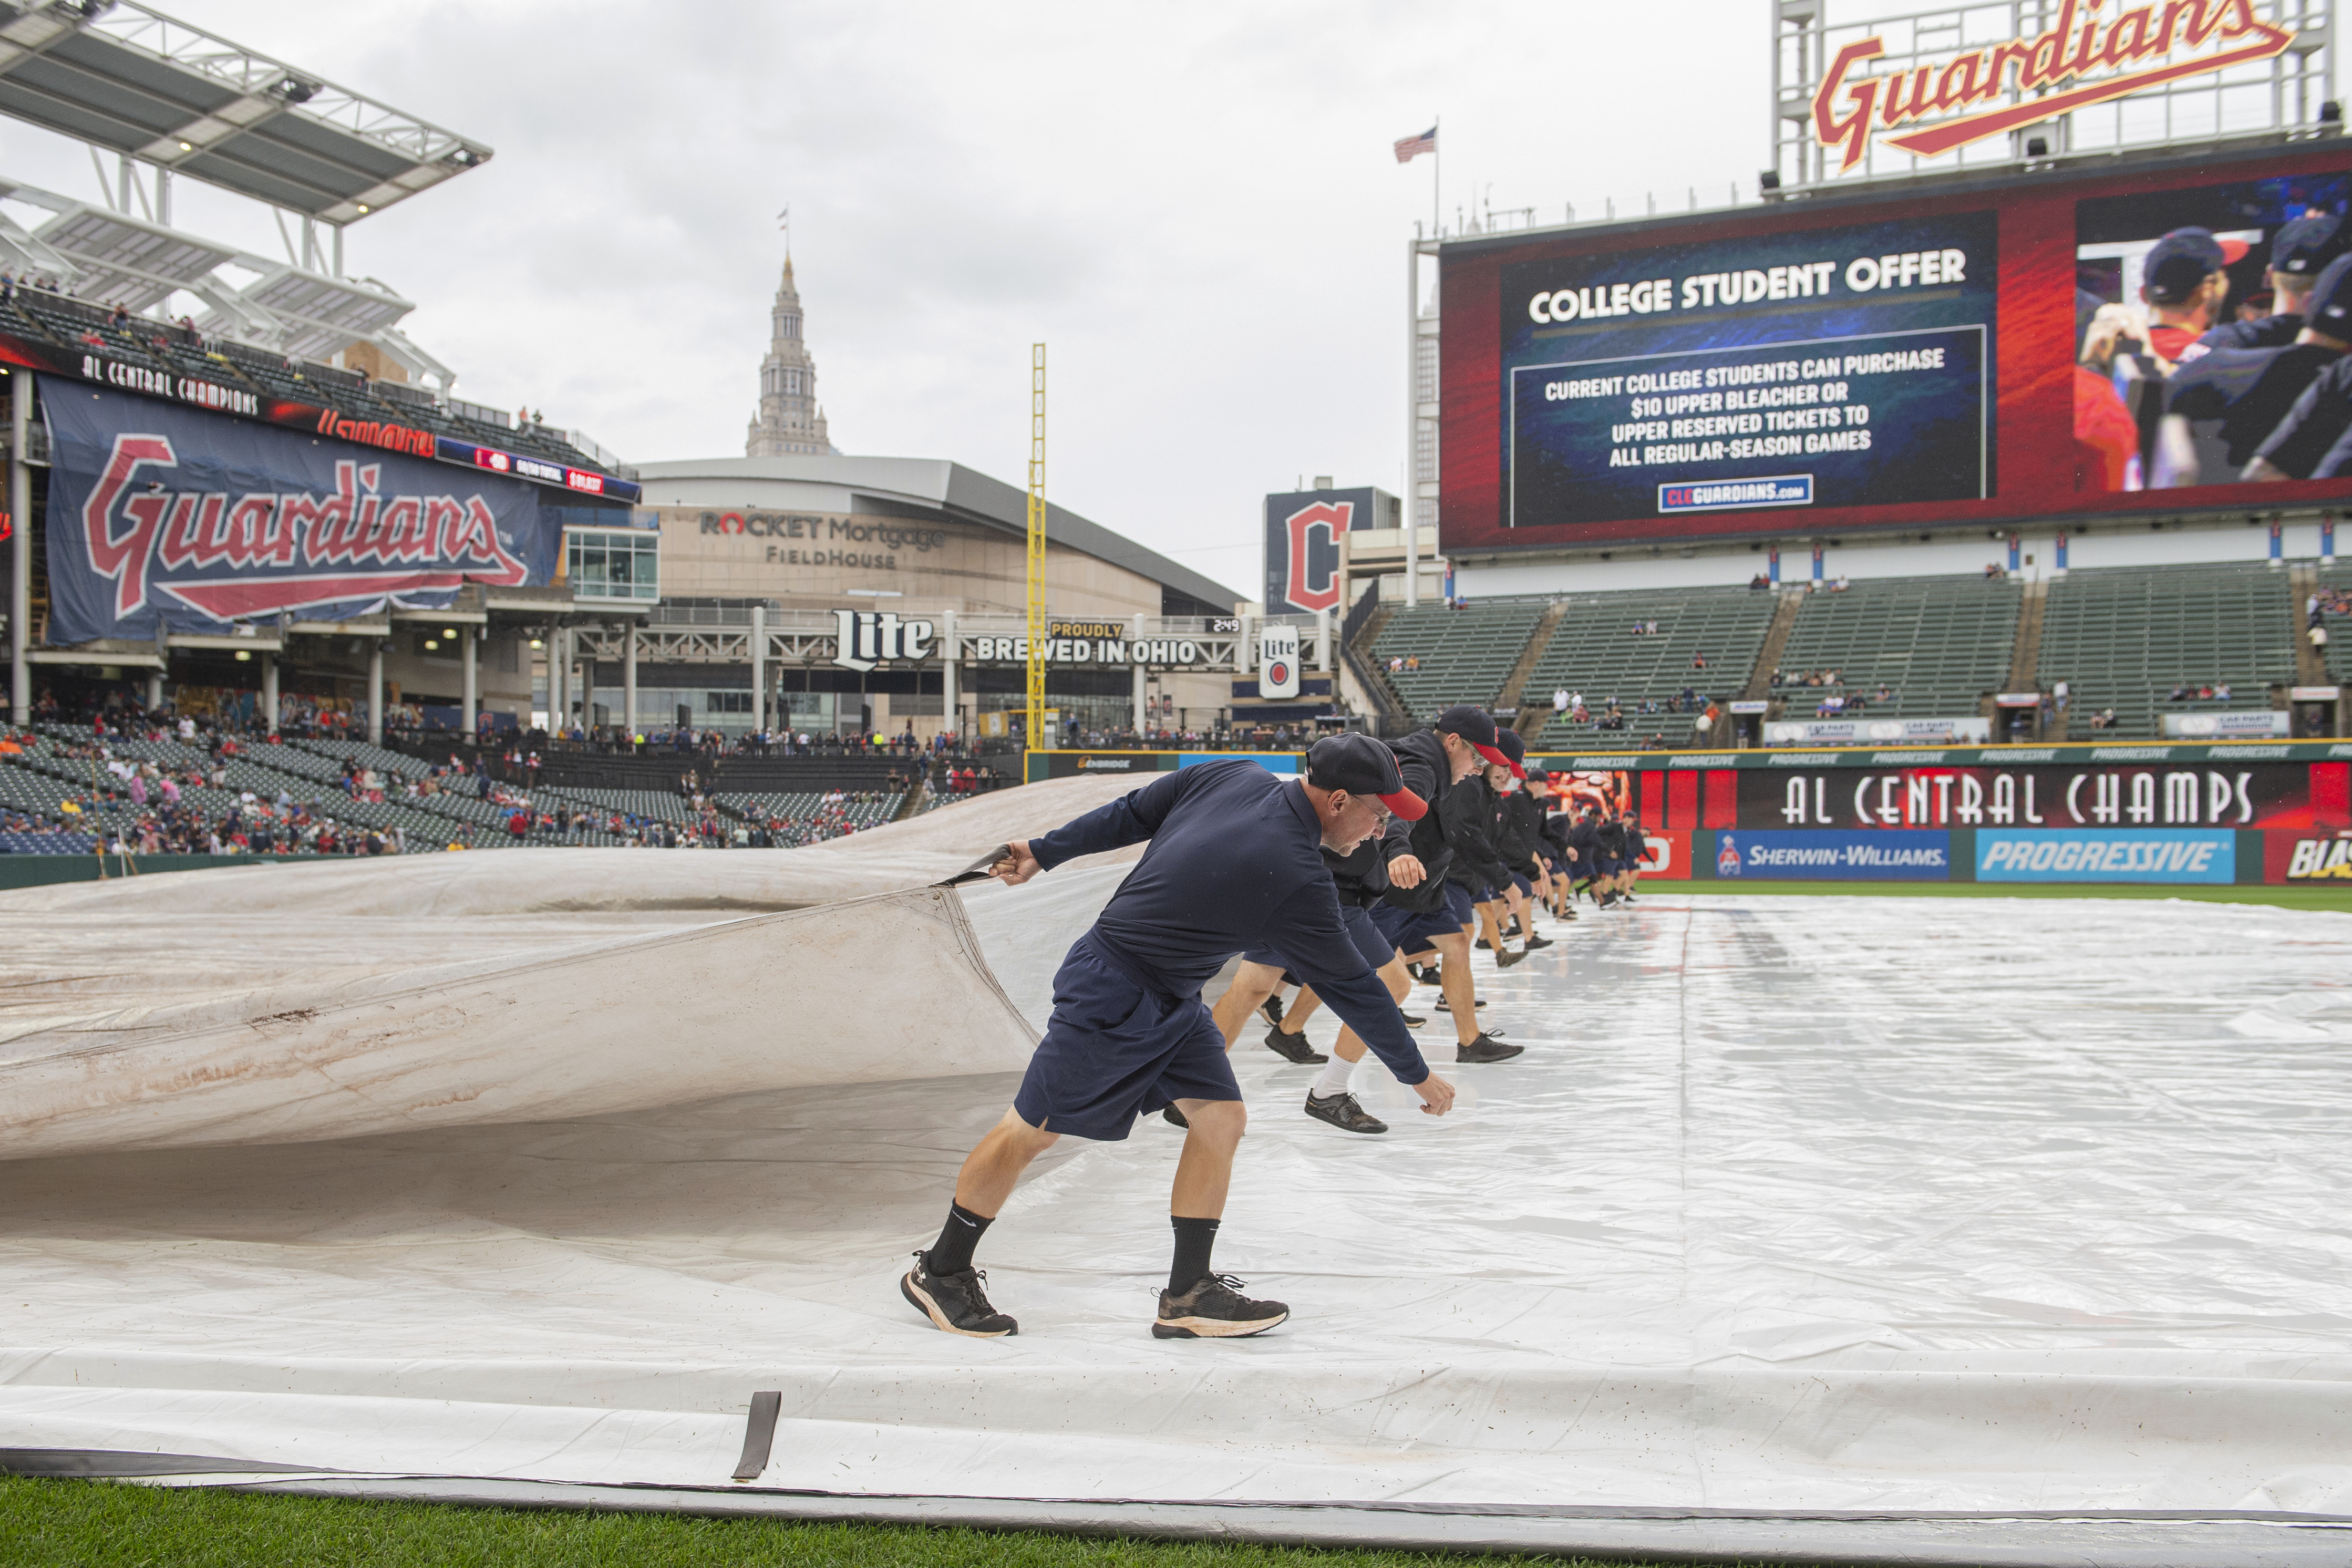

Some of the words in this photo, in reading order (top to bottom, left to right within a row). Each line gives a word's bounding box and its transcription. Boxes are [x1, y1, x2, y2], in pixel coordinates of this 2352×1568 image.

[1810, 0, 2298, 176] Guardians
[1529, 279, 1672, 324] COLLEGE
[1682, 262, 1835, 309] STUDENT
[1845, 249, 1966, 292] OFFER
[82, 355, 102, 380] AL
[108, 362, 173, 397] CENTRAL
[178, 377, 258, 415] CHAMPIONS
[1545, 376, 1624, 401] CURRENT
[1626, 370, 1702, 394] COLLEGE
[1705, 360, 1799, 387] STUDENTS
[1801, 357, 1840, 379] CAN
[1844, 348, 1945, 376] PURCHASE
[1631, 397, 1662, 420] $10
[1665, 392, 1722, 415] UPPER
[1726, 384, 1819, 409] BLEACHER
[1822, 382, 1848, 402] OR
[1612, 421, 1668, 443] UPPER
[1672, 414, 1762, 438] RESERVED
[1765, 406, 1841, 431] TICKETS
[1844, 405, 1869, 425] TO
[1610, 448, 1641, 467] ALL
[1644, 435, 1801, 465] REGULAR-SEASON
[1805, 429, 1871, 453] GAMES
[82, 433, 529, 621] Guardians
[700, 512, 822, 538] ROCKET
[829, 518, 947, 551] Mortgage
[1285, 501, 1354, 613] C
[831, 608, 933, 672] Lite
[1051, 623, 1123, 637] PROUDLY
[1213, 619, 1239, 632] 2:49
[977, 637, 1091, 662] BREWED
[1098, 640, 1125, 663] IN
[1132, 640, 1196, 664] OHIO
[1264, 639, 1294, 660] Lite
[1572, 757, 1638, 768] PROGRESSIVE
[1668, 755, 1736, 767] PROGRESSIVE
[1768, 753, 1839, 765] PROGRESSIVE
[1871, 751, 1945, 764] PROGRESSIVE
[1978, 749, 2055, 761] PROGRESSIVE
[2090, 747, 2171, 760] PROGRESSIVE
[2207, 745, 2291, 758] PROGRESSIVE
[1781, 776, 1832, 824] AL
[1854, 773, 2043, 824] CENTRAL
[2066, 771, 2252, 823] CHAMPS
[1982, 841, 2218, 872] PROGRESSIVE
[2287, 839, 2352, 878] BLA
